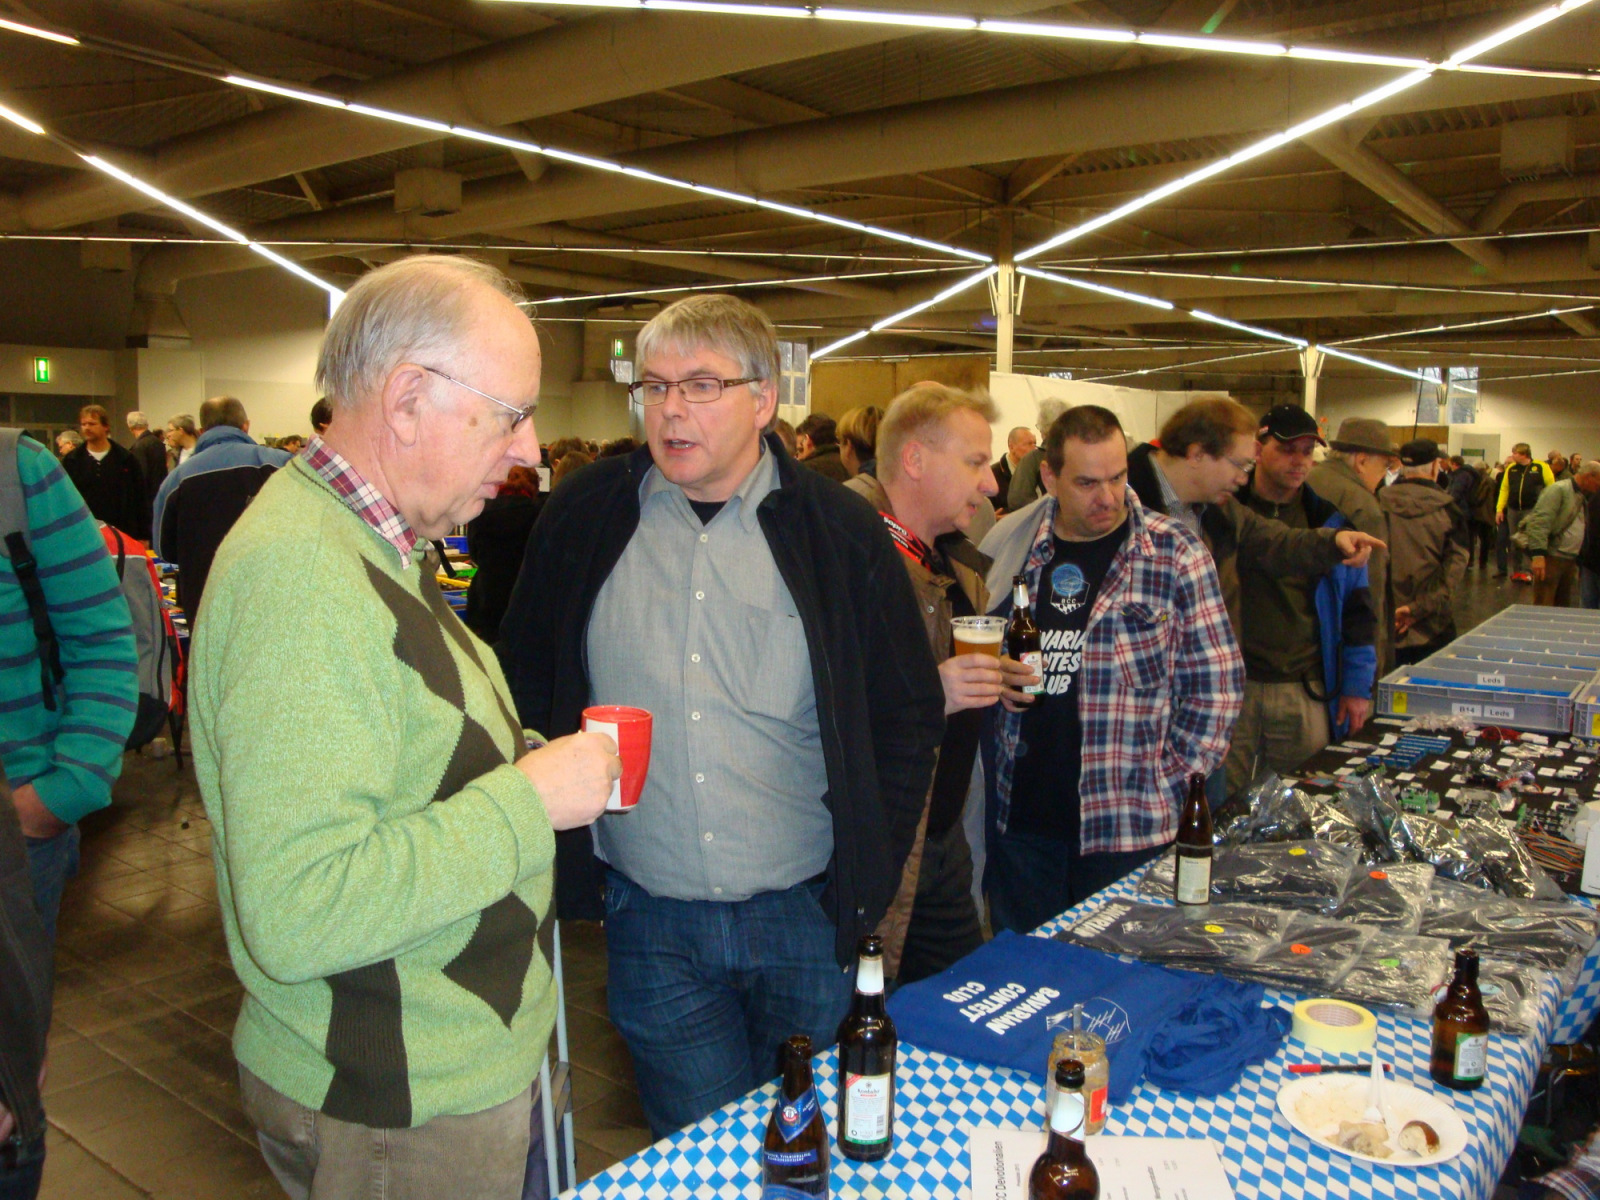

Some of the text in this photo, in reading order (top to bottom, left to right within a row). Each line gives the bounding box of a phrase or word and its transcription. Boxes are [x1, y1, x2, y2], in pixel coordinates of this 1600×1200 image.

[1040, 629, 1088, 651] VARIA
[1043, 651, 1082, 673] NTES
[1482, 676, 1501, 684] Leds
[1490, 709, 1510, 718] Leds
[942, 981, 986, 1003] CLUB
[959, 982, 1027, 1023] CONTEST
[985, 986, 1060, 1036] BAVARIAN
[993, 1141, 1007, 1190] Devotionalien
